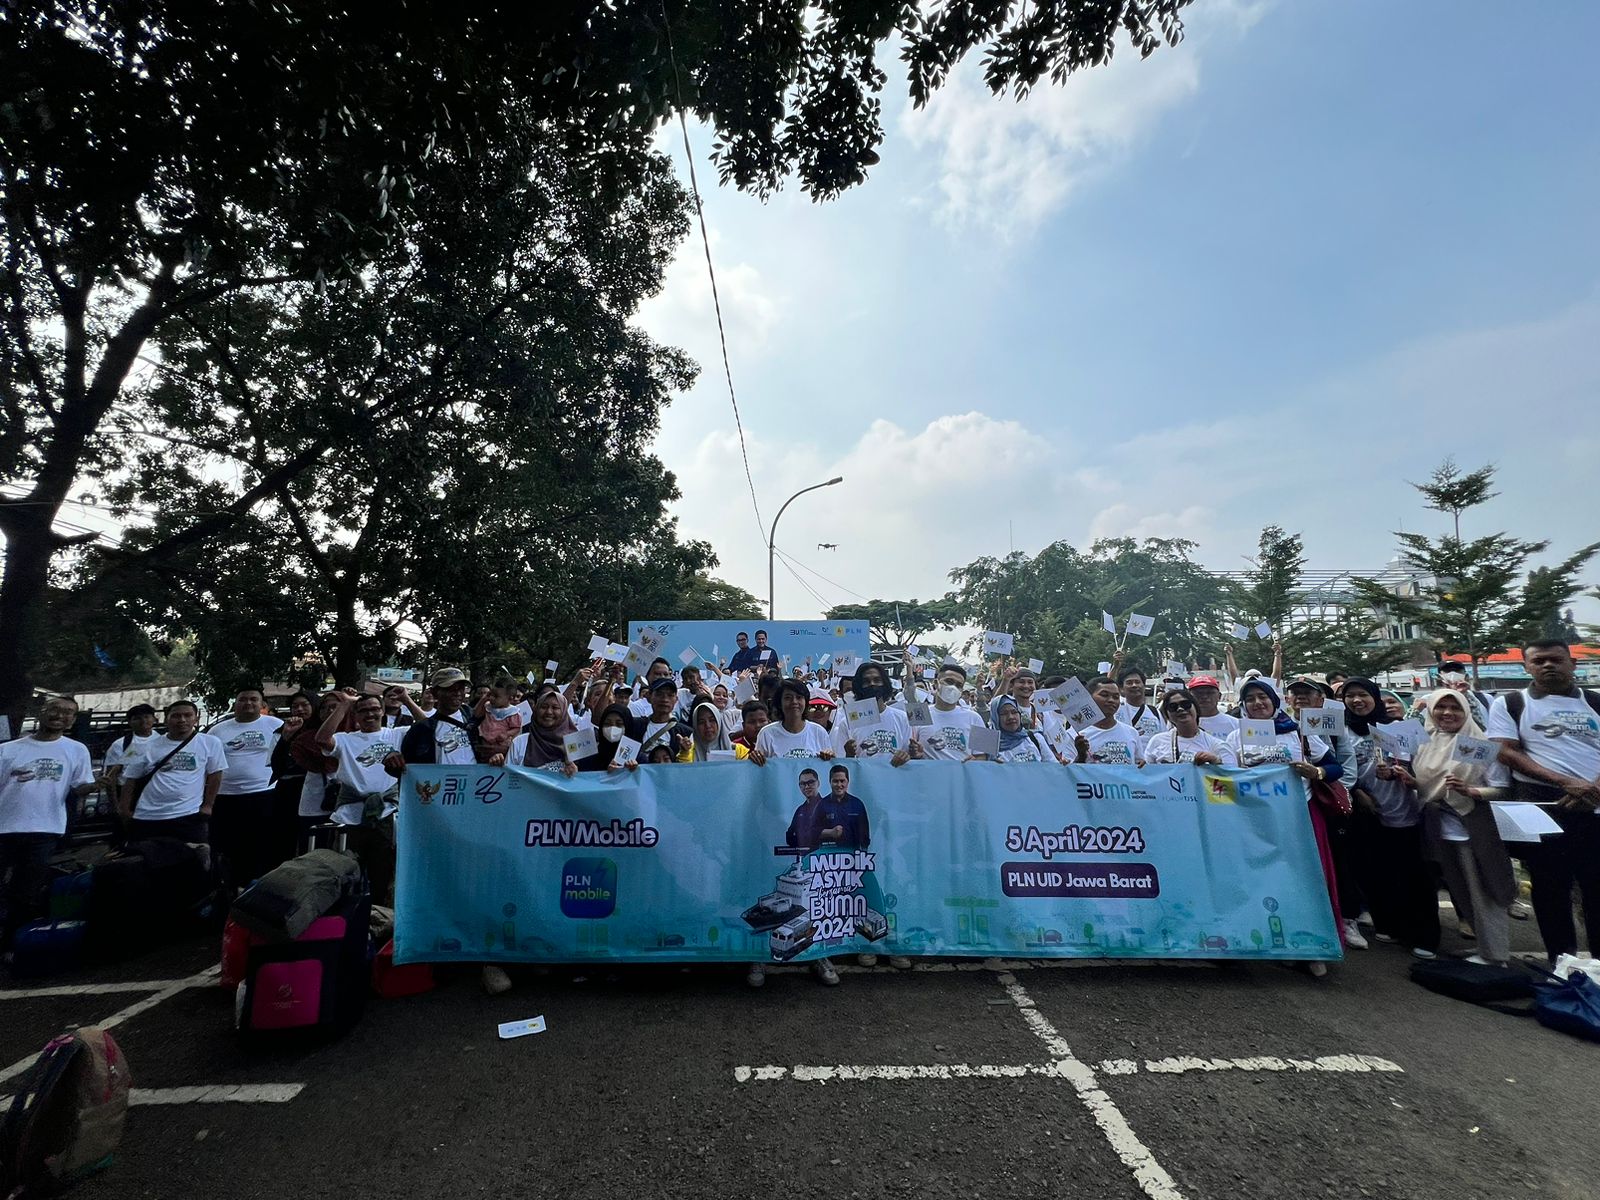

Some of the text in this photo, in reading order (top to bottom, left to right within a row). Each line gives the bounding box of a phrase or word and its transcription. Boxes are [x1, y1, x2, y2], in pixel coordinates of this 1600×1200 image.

[858, 710, 874, 719] PLN
[1076, 782, 1131, 800] BUMN
[1238, 781, 1288, 797] PLN
[527, 821, 656, 845] PLN Mobile
[1008, 827, 1143, 857] 5 April 2024
[565, 875, 591, 886] PLN
[811, 871, 864, 889] ASYIK
[1008, 872, 1152, 888] PLN UID Jawa Barat
[565, 887, 611, 900] mobile
[810, 894, 867, 920] BUMN
[812, 917, 855, 941] 2024
